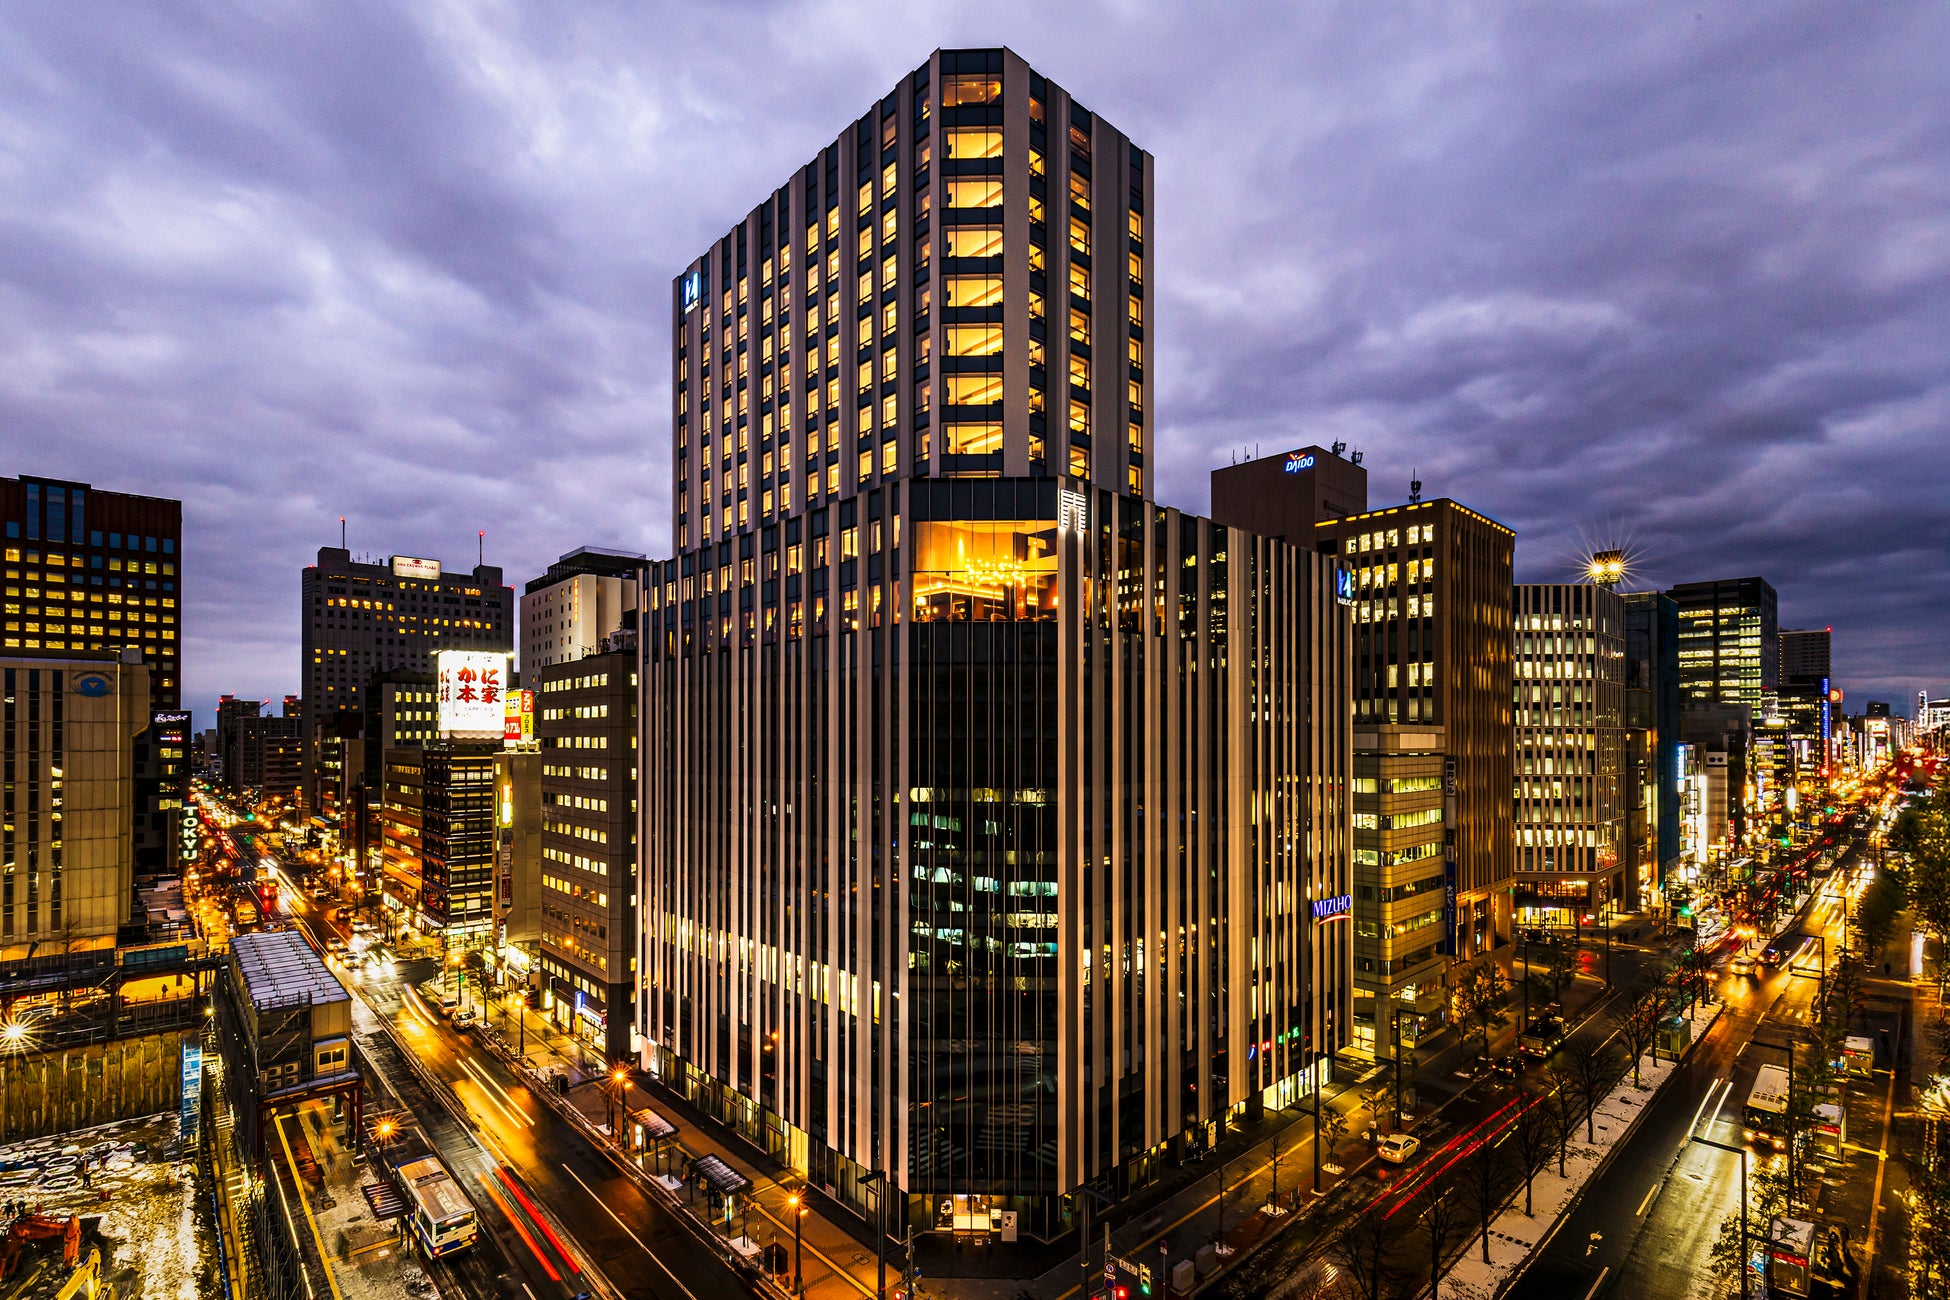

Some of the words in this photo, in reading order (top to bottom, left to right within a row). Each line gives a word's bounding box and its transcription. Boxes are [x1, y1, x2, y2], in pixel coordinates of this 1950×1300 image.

[1285, 456, 1314, 473] DAIDO
[457, 666, 500, 685] かに
[456, 684, 501, 704] 本家
[182, 806, 199, 860] TOKYU
[1313, 894, 1353, 918] MIZUHO
